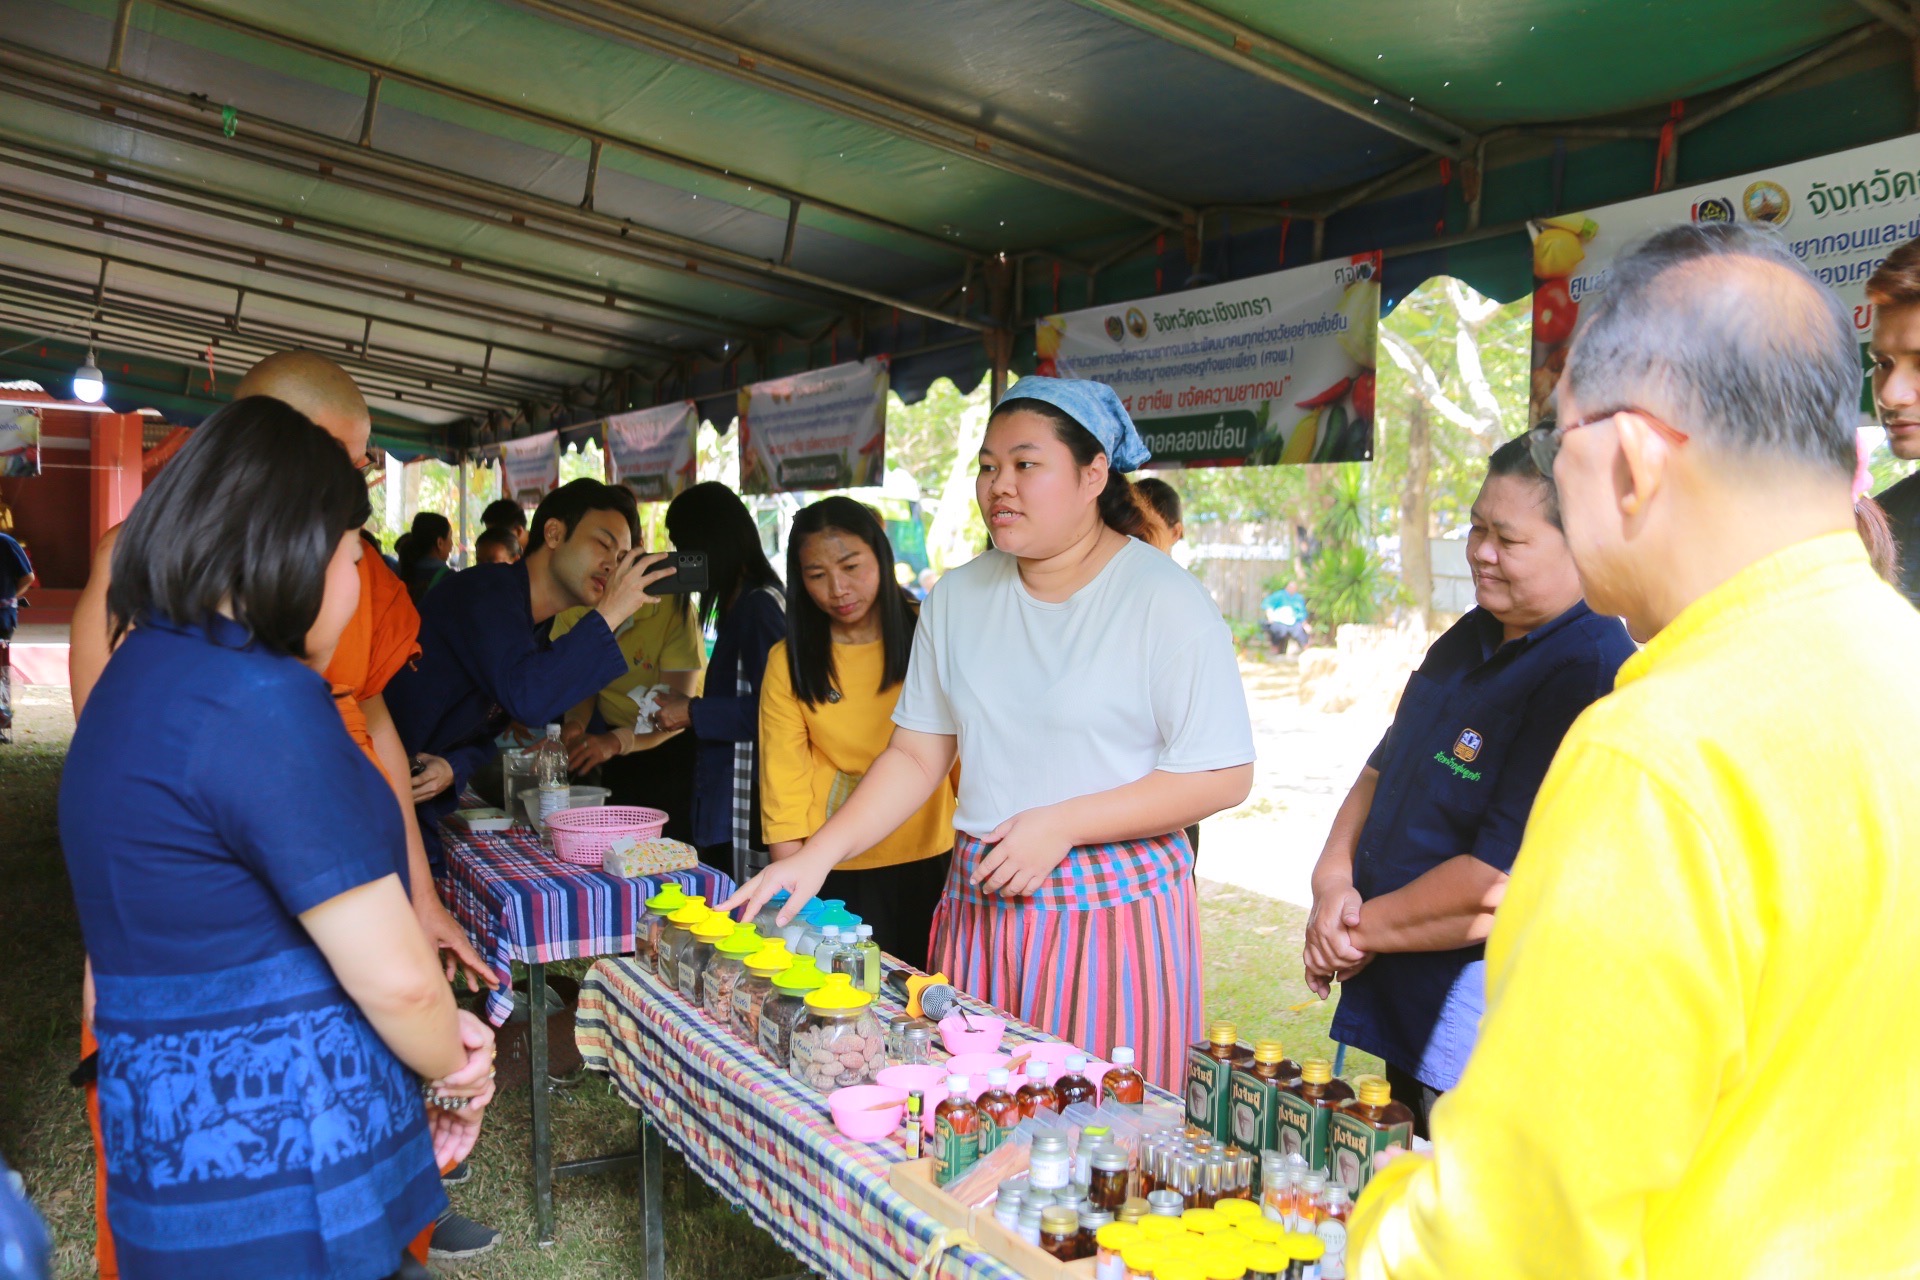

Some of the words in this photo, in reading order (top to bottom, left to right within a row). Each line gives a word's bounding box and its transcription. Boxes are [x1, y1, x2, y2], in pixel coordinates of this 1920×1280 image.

[1807, 169, 1920, 215] จังหวัด
[1153, 297, 1272, 333] จังหวัดฉะเชิงเทรา
[1138, 388, 1173, 411] อาชีพ
